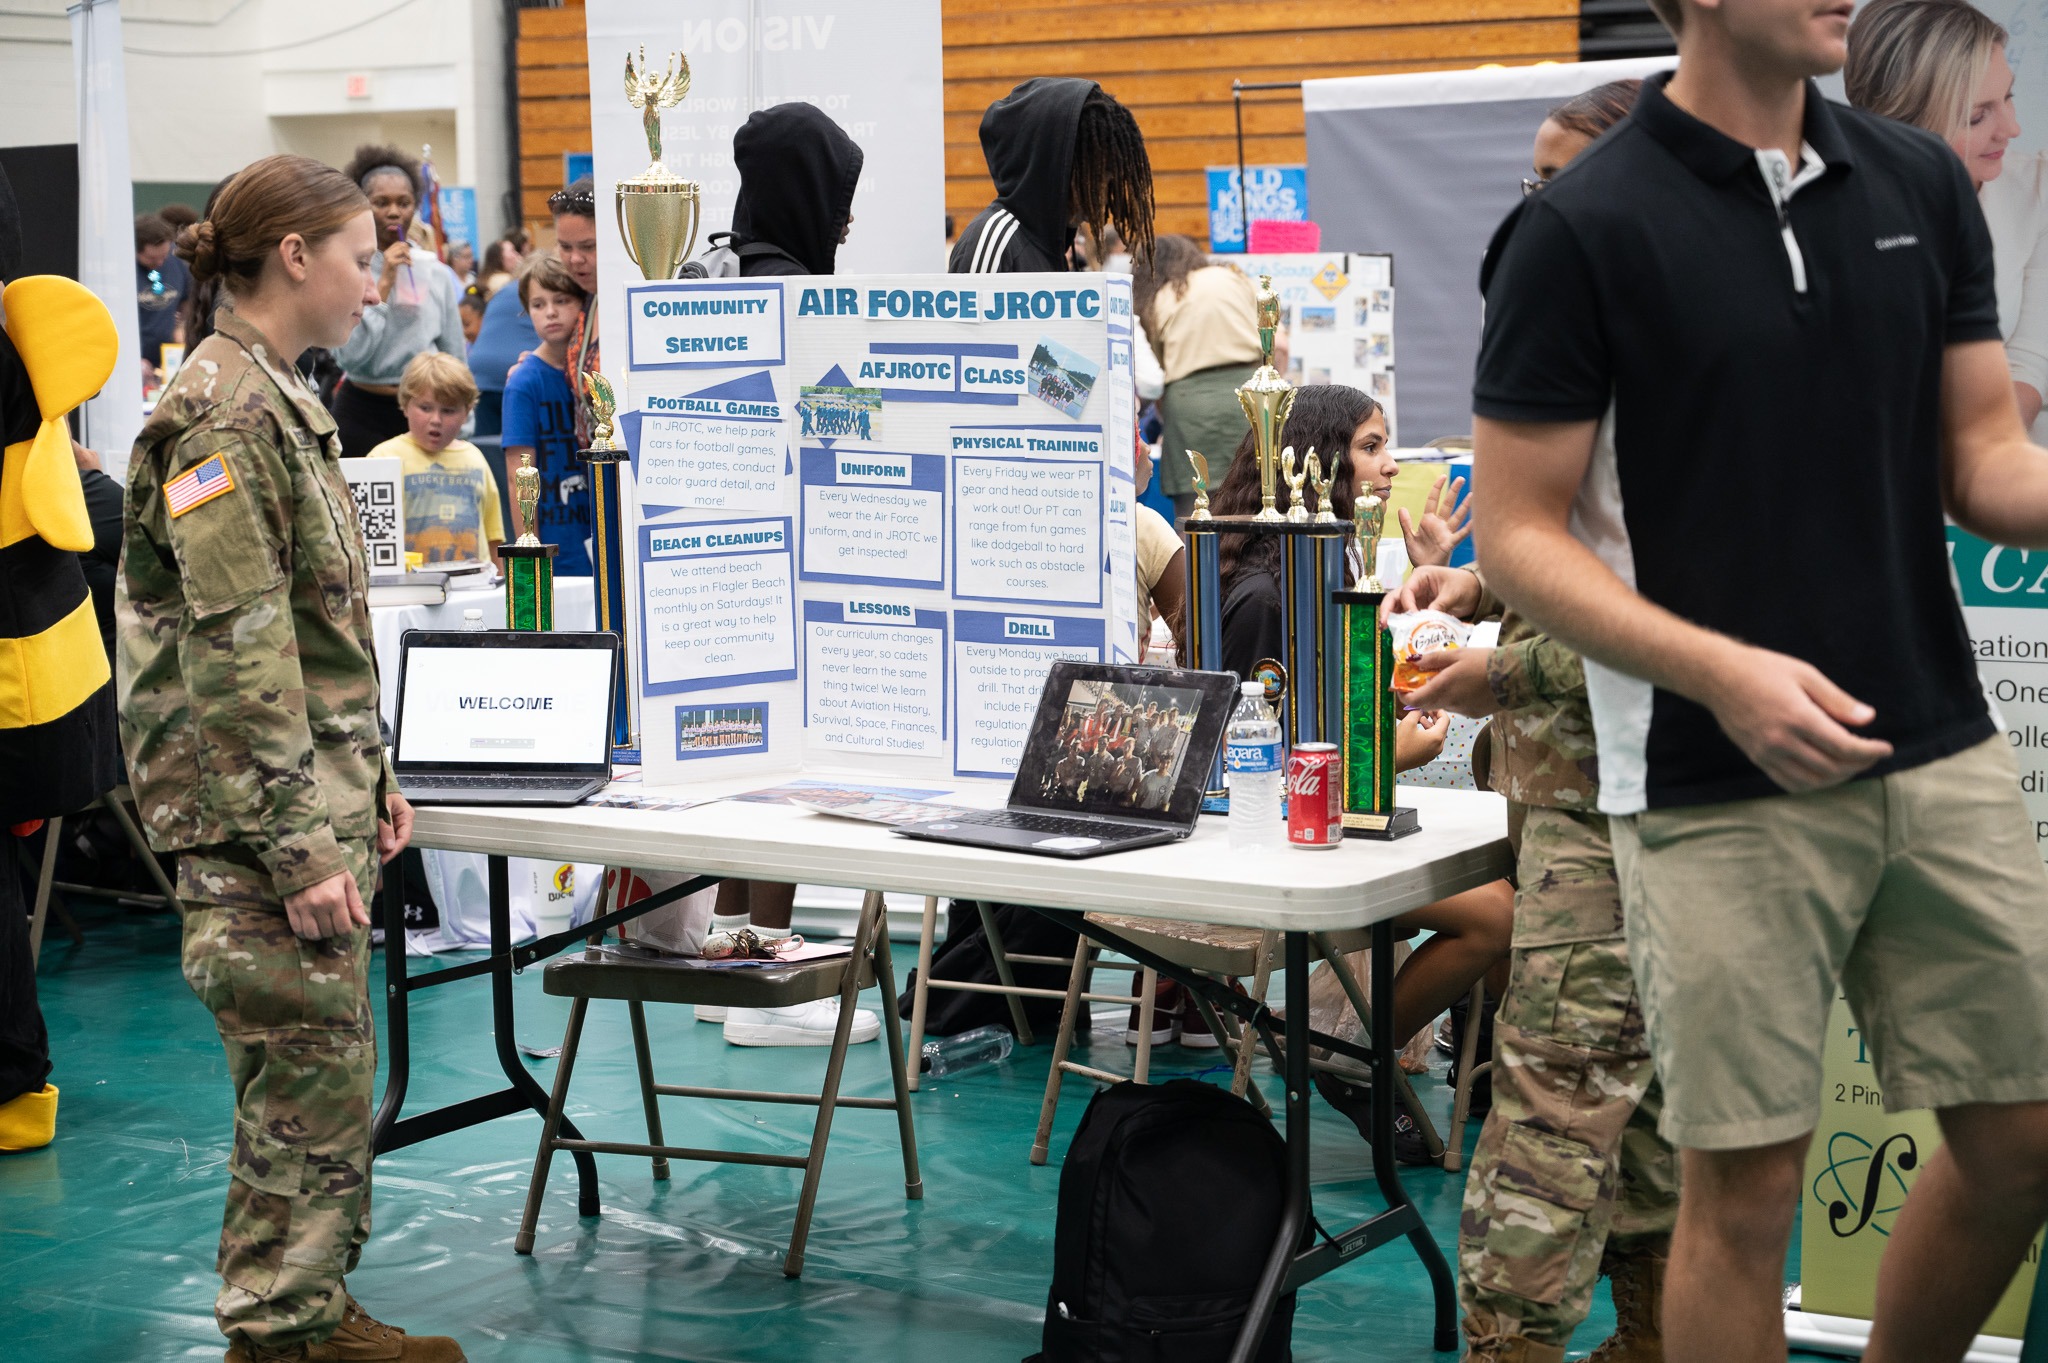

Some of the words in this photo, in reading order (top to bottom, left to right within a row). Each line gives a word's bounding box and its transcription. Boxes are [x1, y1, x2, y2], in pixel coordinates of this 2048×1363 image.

[1228, 169, 1283, 191] OLD
[1218, 188, 1297, 210] KINGS
[643, 299, 768, 317] COMMUNITY
[798, 287, 859, 316] AIR
[868, 289, 977, 319] FORCE
[984, 289, 1100, 320] JROTC
[666, 336, 748, 353] SERVICE
[859, 361, 951, 380] AFJROTC
[964, 367, 1026, 385] CLASS
[648, 396, 721, 413] FOOTBALL
[726, 402, 780, 417] GAMES
[652, 421, 661, 430] In
[665, 422, 704, 434] JROTC,
[726, 426, 748, 437] help
[751, 428, 776, 438] park
[650, 440, 672, 449] cars
[676, 440, 689, 449] for
[694, 441, 734, 453] football
[738, 445, 776, 456] games,
[952, 437, 1024, 449] PHYSICAL
[1027, 439, 1099, 453] TRAINING
[648, 458, 674, 467] open
[678, 458, 694, 468] the
[698, 461, 730, 471] gates,
[733, 463, 776, 473] conduct
[841, 463, 905, 477] UNIFORM
[963, 466, 992, 478] Every
[995, 467, 1027, 480] Friday
[1031, 470, 1046, 479] we
[1049, 471, 1075, 480] wear
[1078, 470, 1092, 480] PT
[411, 475, 445, 486] LUCKY
[656, 475, 682, 485] color
[686, 476, 717, 488] guard
[720, 479, 752, 491] detail,
[755, 481, 775, 491] and
[819, 490, 848, 503] Every
[850, 493, 910, 507] Wednesday
[961, 485, 985, 496] gear
[989, 485, 1009, 496] and
[1011, 485, 1038, 497] head
[1041, 487, 1080, 499] outside
[1083, 488, 1093, 499] to
[694, 496, 725, 505] more!
[828, 511, 852, 519] wear
[855, 511, 871, 520] the
[874, 512, 888, 521] Air
[891, 513, 919, 524] Force
[973, 503, 998, 513] work
[1001, 504, 1020, 514] out!
[1023, 505, 1043, 515] Our
[1045, 505, 1059, 515] PT
[1062, 508, 1082, 517] can
[809, 526, 850, 538] uniform,
[852, 529, 871, 539] and
[875, 530, 883, 539] in
[886, 531, 920, 542] JROTC
[924, 535, 938, 543] we
[969, 521, 999, 533] range
[1002, 522, 1027, 533] from
[1030, 523, 1047, 534] fun
[1050, 526, 1087, 536] games
[653, 536, 701, 551] BEACH
[705, 531, 783, 547] CLEANUPS
[971, 539, 988, 549] like
[991, 540, 1043, 553] dodgeball
[1046, 542, 1057, 552] to
[1060, 543, 1084, 554] hard
[839, 546, 854, 556] get
[858, 547, 908, 559] inspected!
[671, 567, 688, 577] We
[692, 564, 726, 576] attend
[729, 561, 761, 573] beach
[970, 557, 995, 567] work
[999, 558, 1022, 569] such
[1025, 561, 1038, 570] as
[1040, 560, 1085, 572] obstacle
[650, 584, 697, 598] cleanups
[700, 582, 709, 592] in
[712, 579, 748, 593] Flagler
[752, 577, 785, 589] Beach
[1006, 578, 1048, 588] courses.
[654, 601, 697, 614] monthly
[700, 602, 714, 610] on
[717, 595, 773, 610] Saturdays!
[776, 595, 782, 605] It
[850, 601, 911, 616] LESSONS
[661, 622, 669, 632] is
[673, 622, 680, 631] a
[683, 619, 711, 632] great
[715, 617, 737, 628] way
[740, 615, 750, 626] to
[753, 613, 776, 625] help
[1009, 622, 1050, 636] DRILL
[665, 639, 691, 650] keep
[694, 638, 710, 646] our
[715, 632, 775, 645] community
[815, 626, 833, 637] Our
[837, 629, 888, 640] curriculum
[892, 632, 934, 645] changes
[705, 653, 735, 664] clean.
[822, 645, 849, 657] every
[852, 648, 876, 659] year,
[879, 650, 891, 658] so
[894, 650, 928, 661] cadets
[966, 646, 996, 659] Every
[999, 647, 1041, 661] Monday
[1044, 651, 1059, 659] we
[1062, 651, 1088, 662] head
[822, 664, 850, 673] never
[852, 664, 878, 675] learn
[881, 667, 896, 676] the
[899, 669, 927, 679] same
[970, 665, 1007, 675] outside
[1010, 666, 1020, 676] to
[823, 680, 848, 693] thing
[851, 682, 879, 693] twice!
[882, 685, 898, 694] We
[900, 686, 926, 696] learn
[978, 683, 998, 692] drill.
[1002, 684, 1025, 695] That
[459, 696, 553, 710] WELCOME
[819, 697, 848, 708] about
[850, 700, 890, 711] Aviation
[893, 703, 931, 716] History,
[984, 701, 1021, 712] include
[812, 714, 853, 727] Survival,
[856, 717, 888, 730] Space,
[891, 720, 938, 734] Finances,
[975, 719, 1030, 731] regulation,
[825, 733, 843, 743] and
[846, 734, 884, 746] Cultural
[886, 737, 925, 750] Studies!
[1227, 747, 1262, 760] agara
[1835, 1083, 1845, 1102] 2
[1853, 1085, 1880, 1105] Pin
